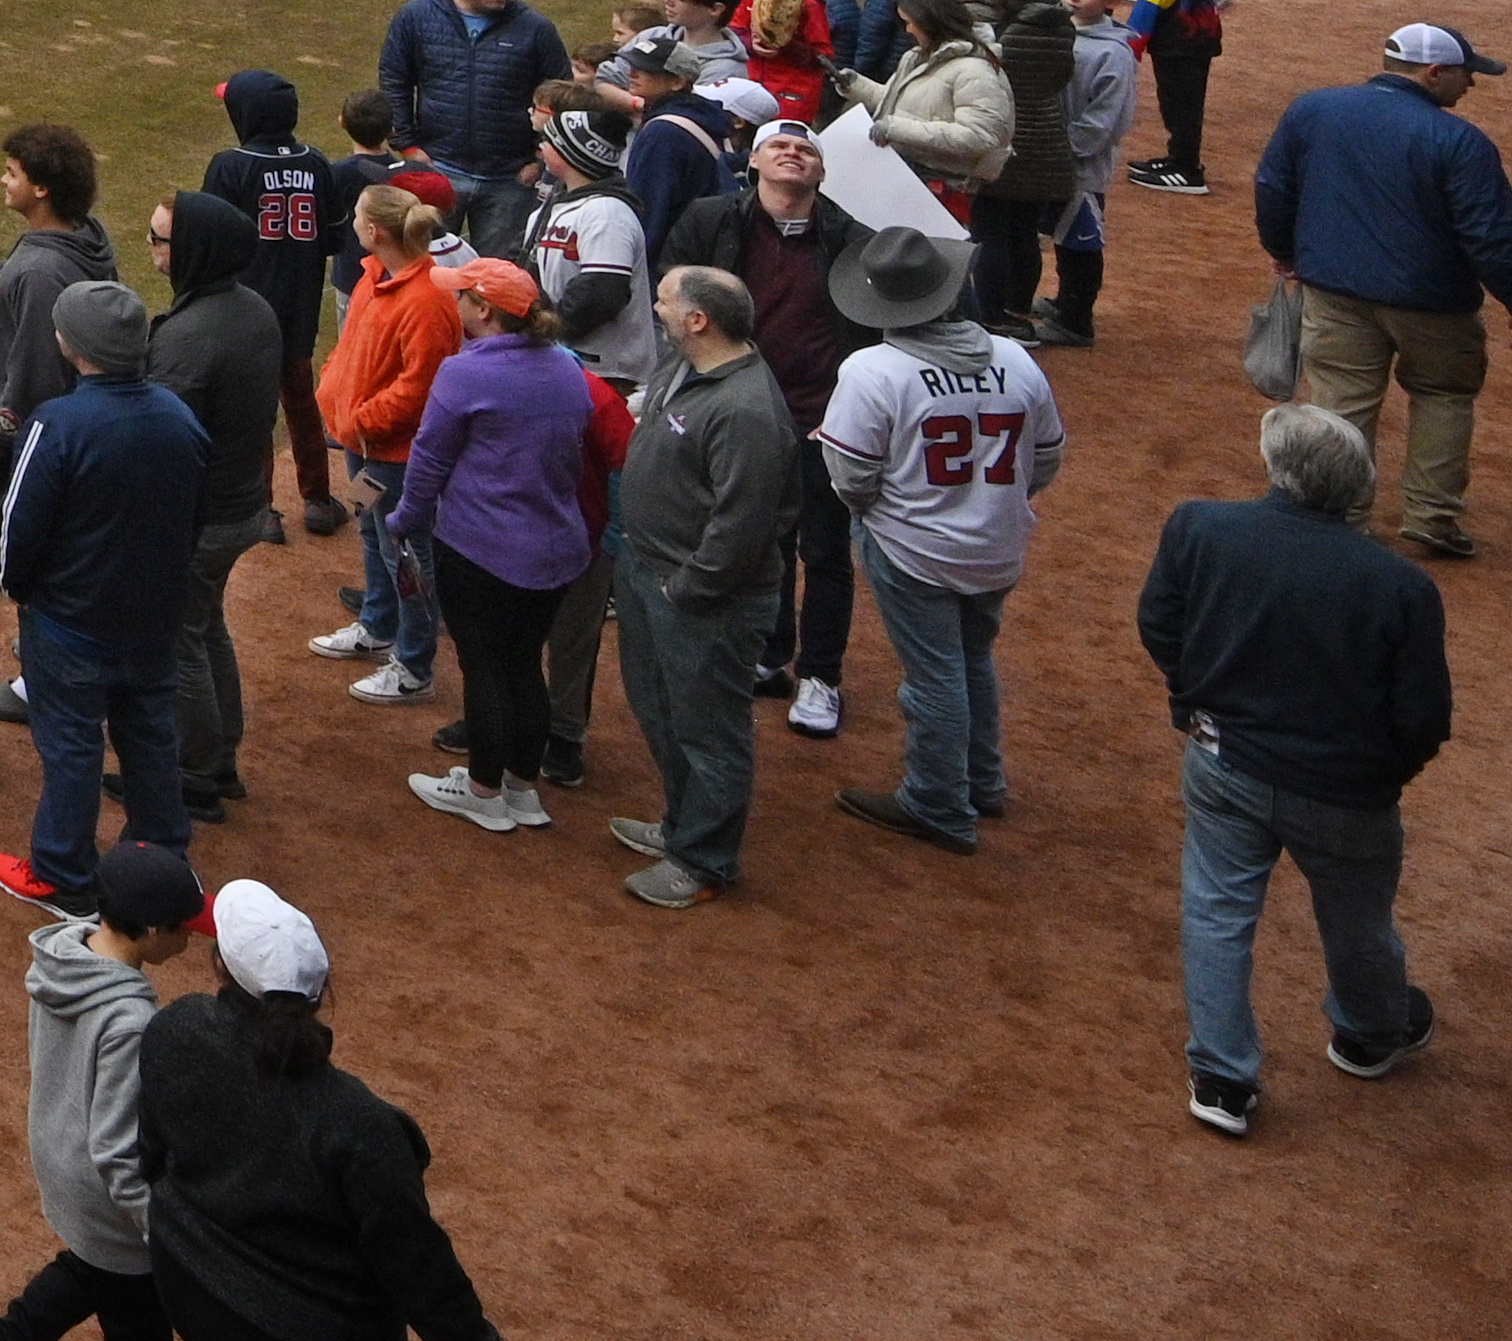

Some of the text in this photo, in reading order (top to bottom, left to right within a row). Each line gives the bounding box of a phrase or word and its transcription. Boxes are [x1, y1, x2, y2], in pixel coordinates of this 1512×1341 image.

[264, 169, 315, 191] OLSON
[258, 192, 318, 241] 28
[921, 411, 1025, 487] 27
